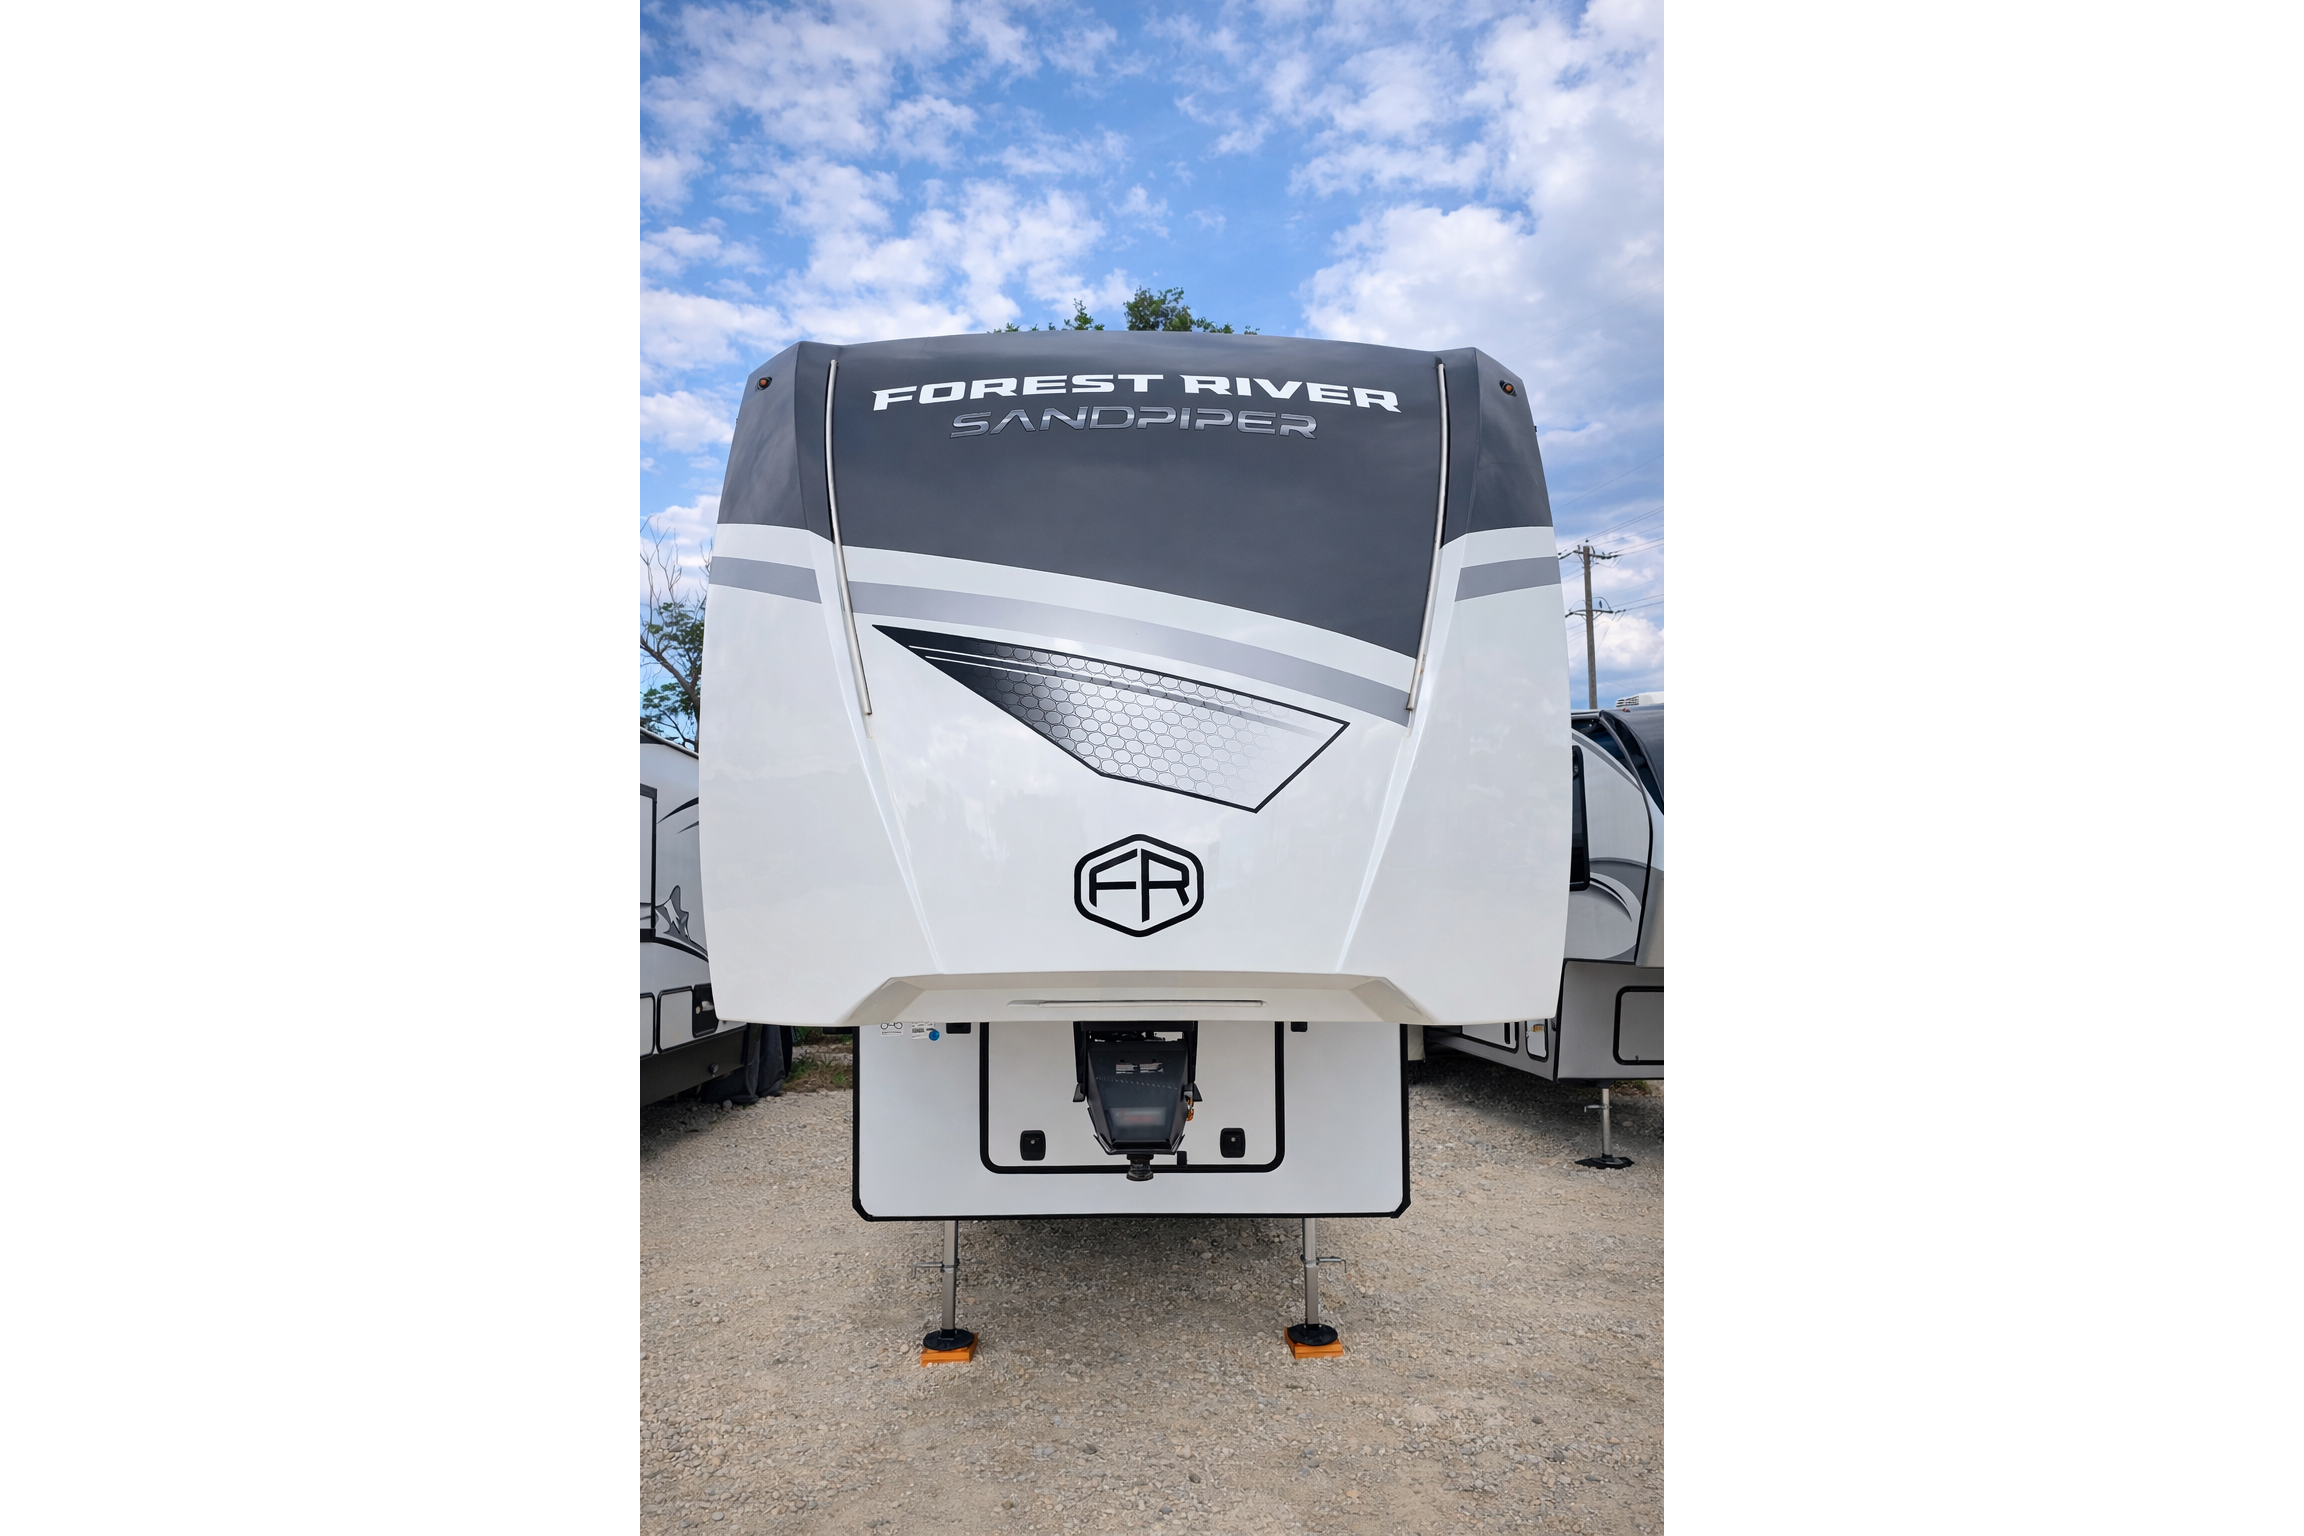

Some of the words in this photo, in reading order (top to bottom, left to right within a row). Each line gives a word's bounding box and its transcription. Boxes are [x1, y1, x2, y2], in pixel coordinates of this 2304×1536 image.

[872, 374, 1164, 412] FOREST
[1179, 374, 1402, 413] RIVER
[949, 405, 1318, 440] SANDPIPER
[1088, 847, 1190, 923] FR
